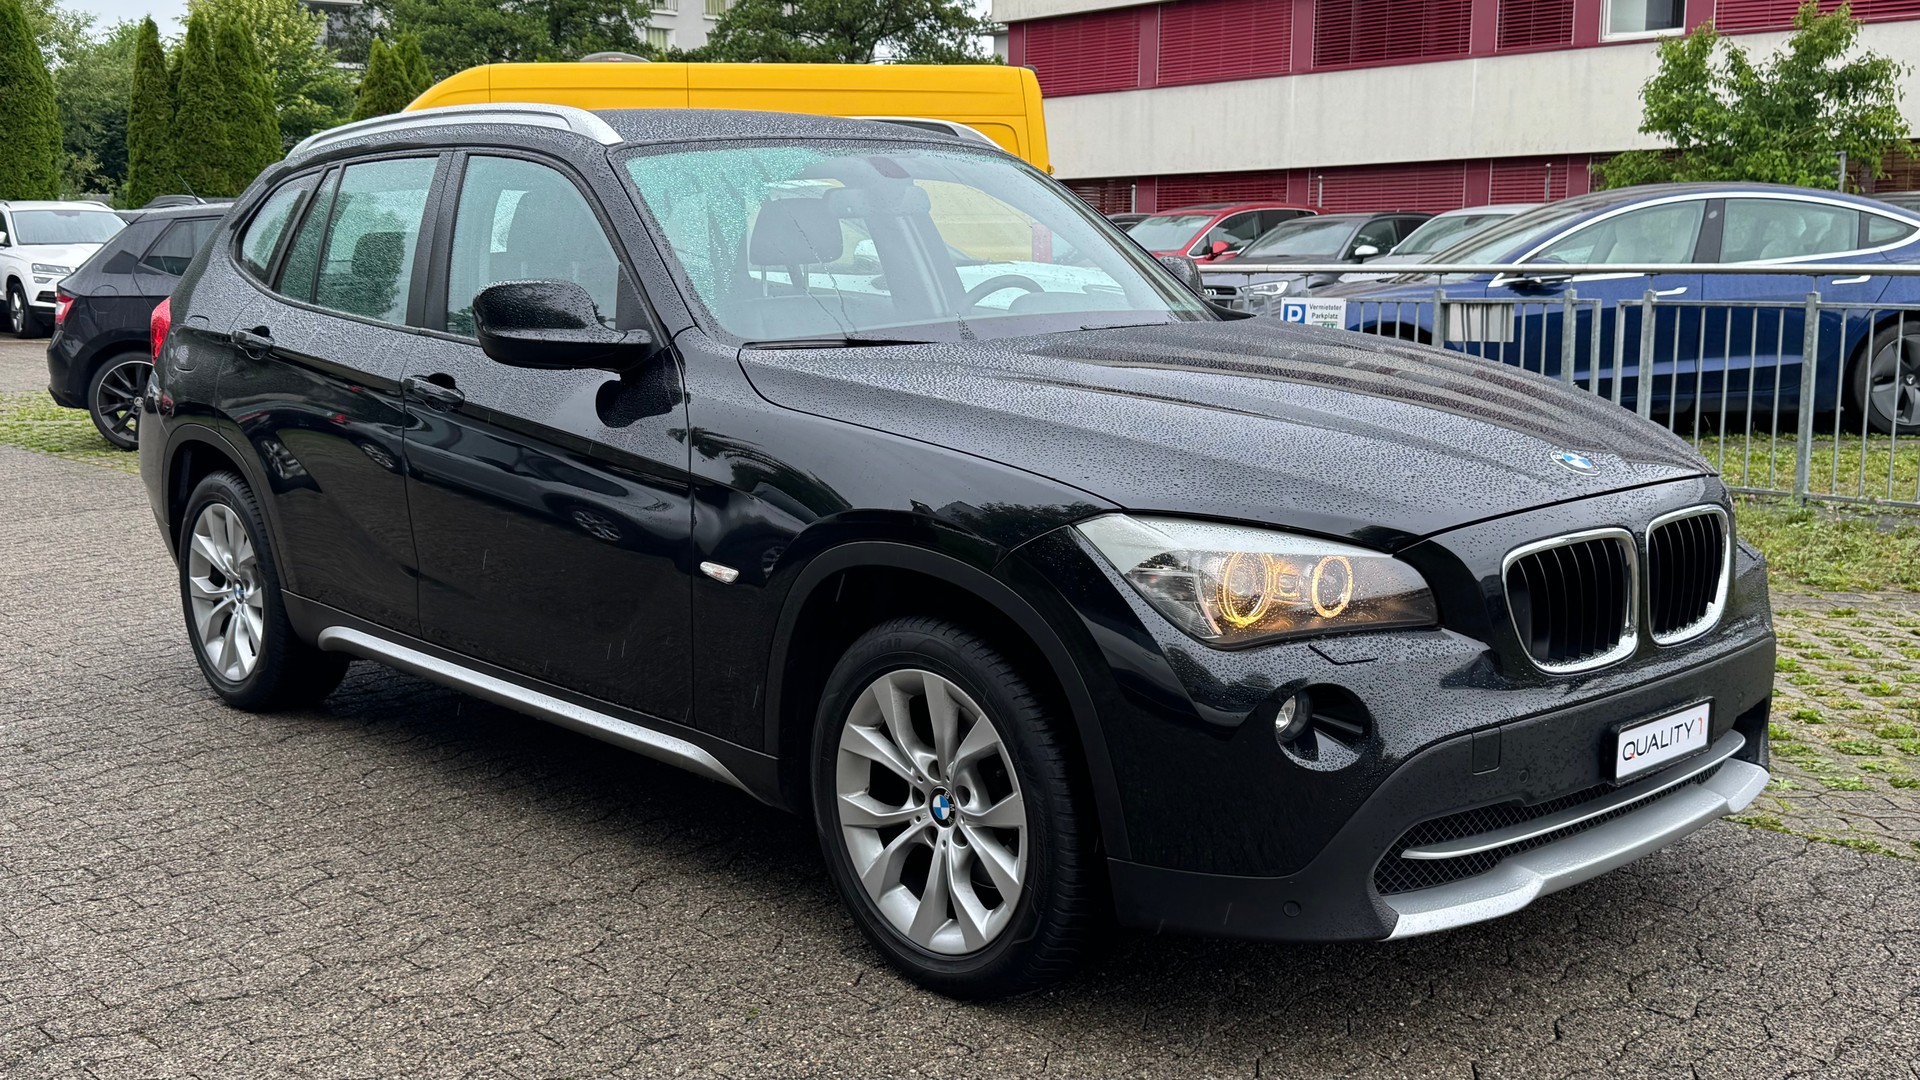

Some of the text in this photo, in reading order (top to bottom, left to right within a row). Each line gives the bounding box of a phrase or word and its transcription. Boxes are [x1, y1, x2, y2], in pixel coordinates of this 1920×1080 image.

[1287, 305, 1303, 322] P
[1311, 312, 1338, 320] Parkplatz
[1623, 719, 1695, 761] QUALITY
